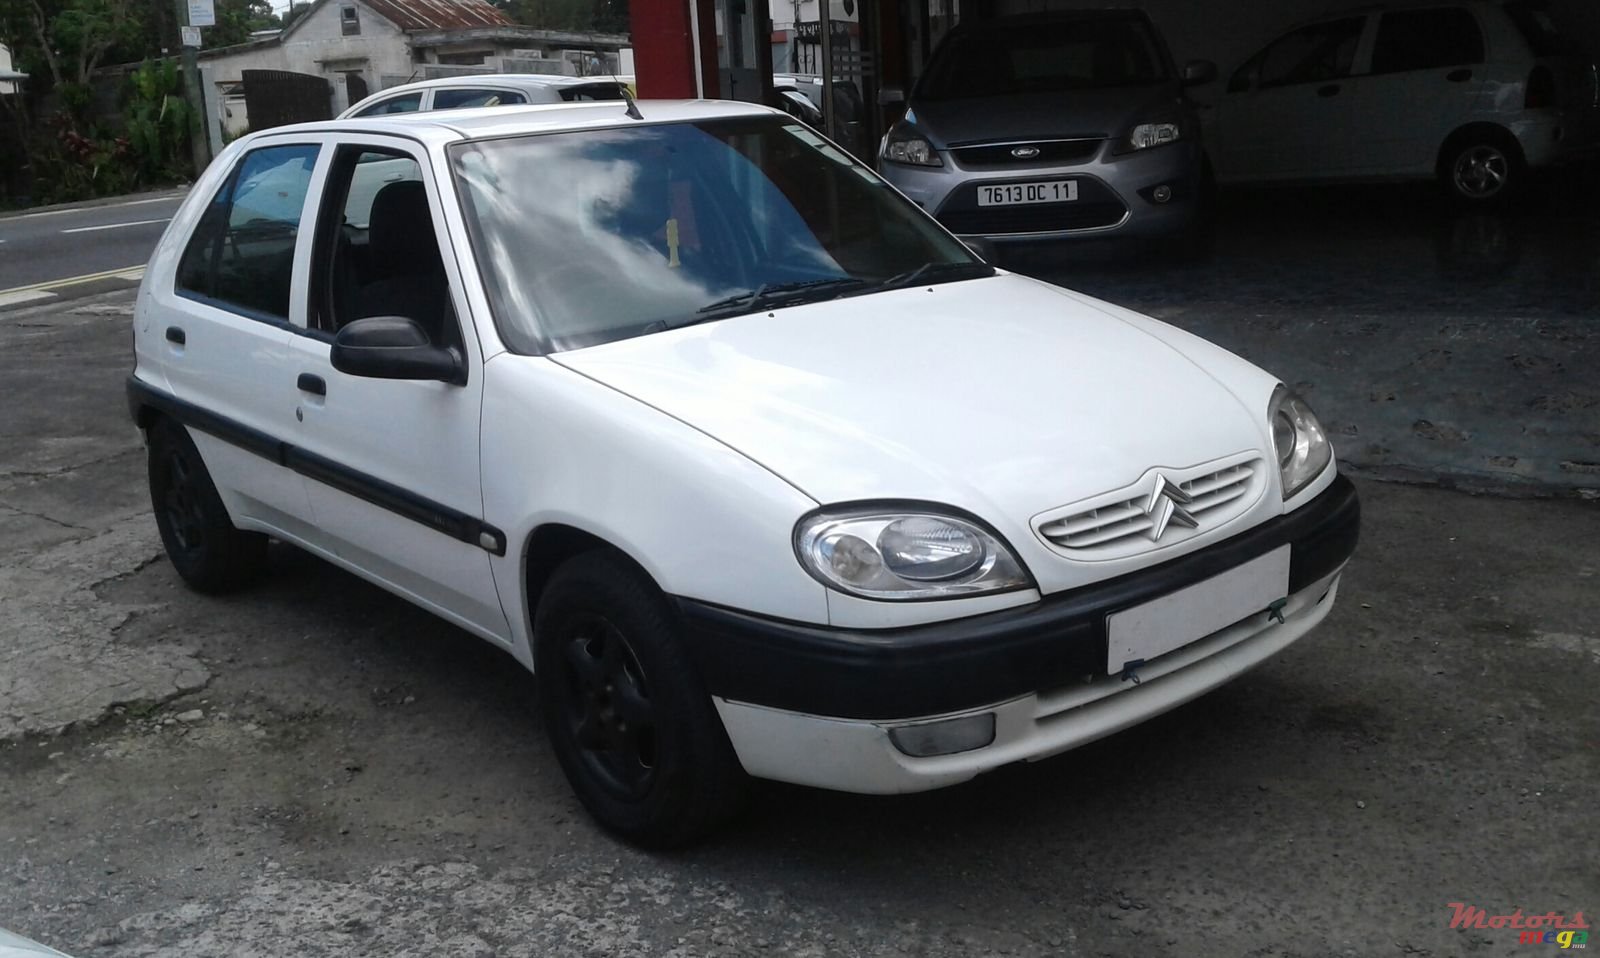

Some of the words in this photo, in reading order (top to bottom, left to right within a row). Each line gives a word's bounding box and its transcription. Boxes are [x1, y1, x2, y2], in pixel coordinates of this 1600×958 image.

[984, 187, 1022, 203] 7613
[1027, 185, 1046, 201] DC
[1053, 183, 1069, 199] 11
